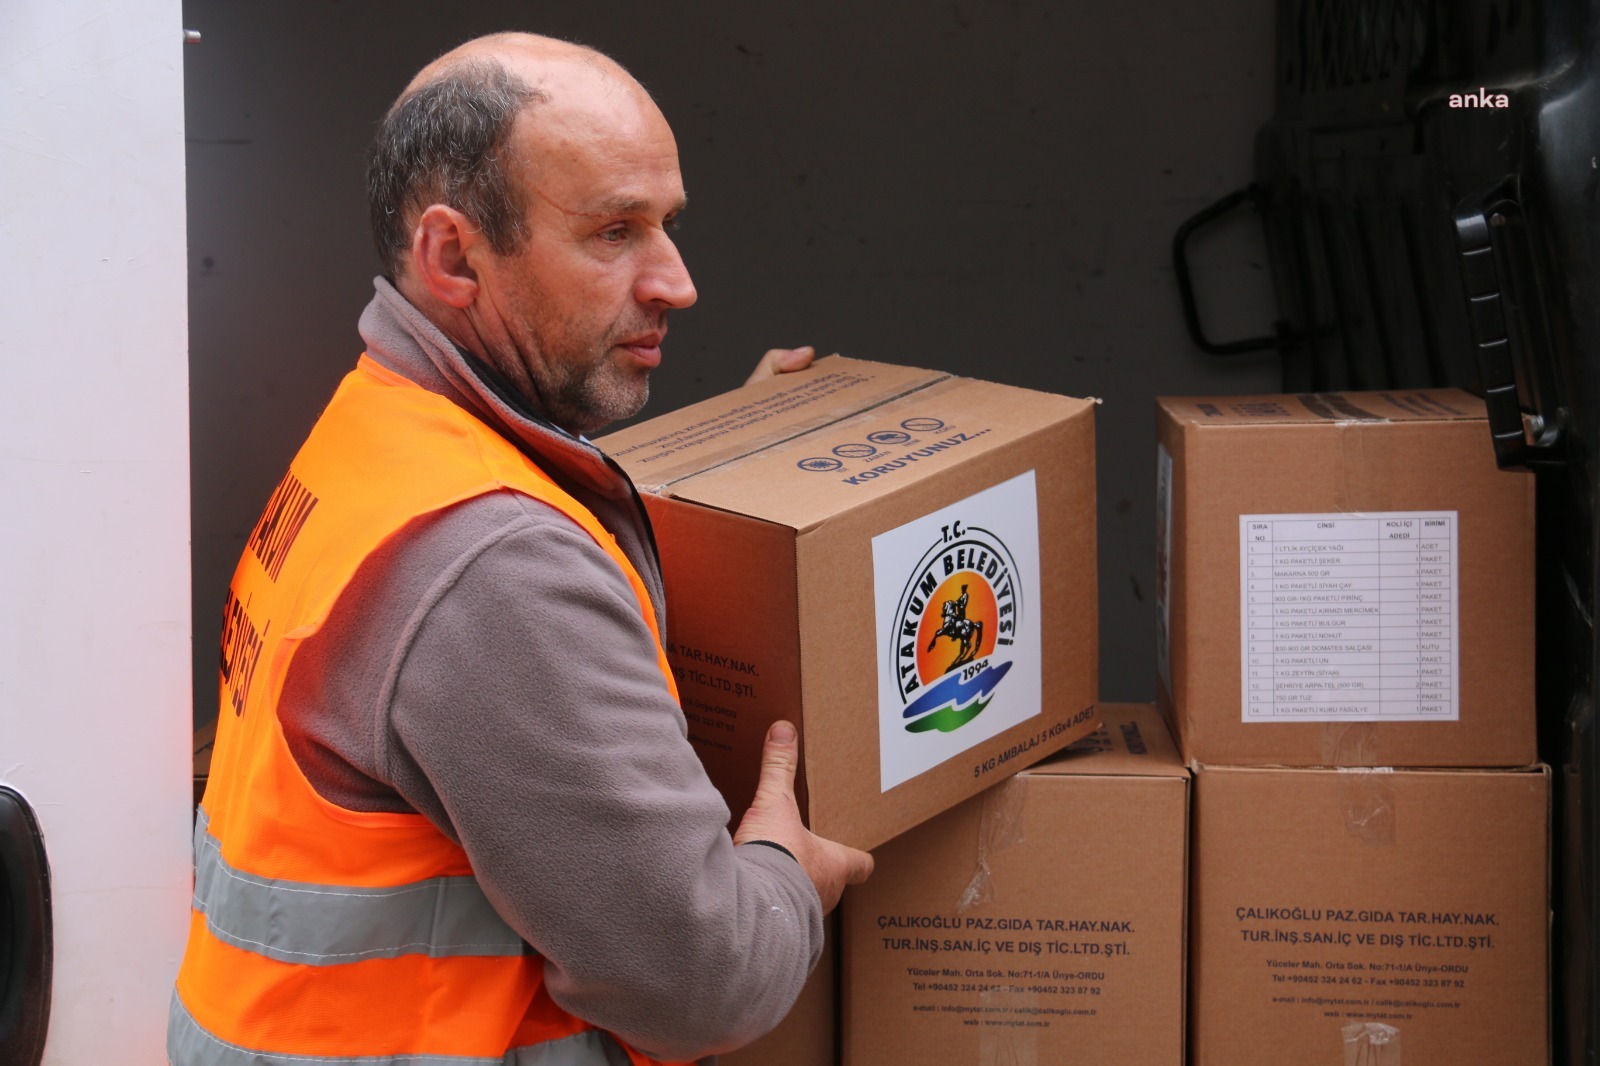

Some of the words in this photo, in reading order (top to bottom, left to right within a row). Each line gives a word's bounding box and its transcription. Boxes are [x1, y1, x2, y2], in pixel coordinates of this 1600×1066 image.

[941, 520, 966, 543] T.C.
[900, 571, 938, 695] ATAKUM
[943, 547, 1014, 646] BELEDİYESİ
[962, 659, 989, 680] 1994
[974, 765, 980, 778] 5
[981, 758, 996, 774] KG
[997, 735, 1041, 766] AMBALAJ
[1041, 730, 1047, 742] 5
[1049, 719, 1071, 737] KGx4
[1072, 705, 1095, 724] ADET
[877, 915, 962, 929] ÇALIKOĞLU
[966, 918, 1033, 930] PAZ.GIDA
[1036, 919, 1135, 933] TAR.HAY.NAK.
[1236, 907, 1321, 921] ÇALIKOĞLU
[1326, 910, 1394, 923] PAZ.GIDA
[1398, 911, 1499, 926] TAR.HAY.NAK.
[882, 937, 991, 954] TUR.İNŞ.SAN.İÇ
[995, 940, 1014, 953] VE
[1018, 941, 1042, 956] DIŞ
[1046, 940, 1130, 957] TİC.LTD.ŞTİ.
[1241, 929, 1351, 946] TUR.İNŞ.SAN.İÇ
[1356, 933, 1375, 945] VE
[1380, 934, 1404, 948] DIŞ
[1408, 933, 1495, 950] TİC.LTD.ŞTİ.
[907, 968, 940, 976] Yüceler
[942, 969, 962, 977] Mah.
[1007, 971, 1050, 979] No:71-1/A
[1052, 970, 1105, 980] Ünye-ORDU
[1266, 959, 1300, 968] Yüceler
[1302, 960, 1322, 968] Mah.
[1325, 961, 1345, 969] Orta
[1347, 962, 1366, 970] Sok.
[1369, 963, 1413, 972] No:71-1/A
[1415, 963, 1469, 974] Ünye-ORDU
[912, 1004, 936, 1012] e-mail
